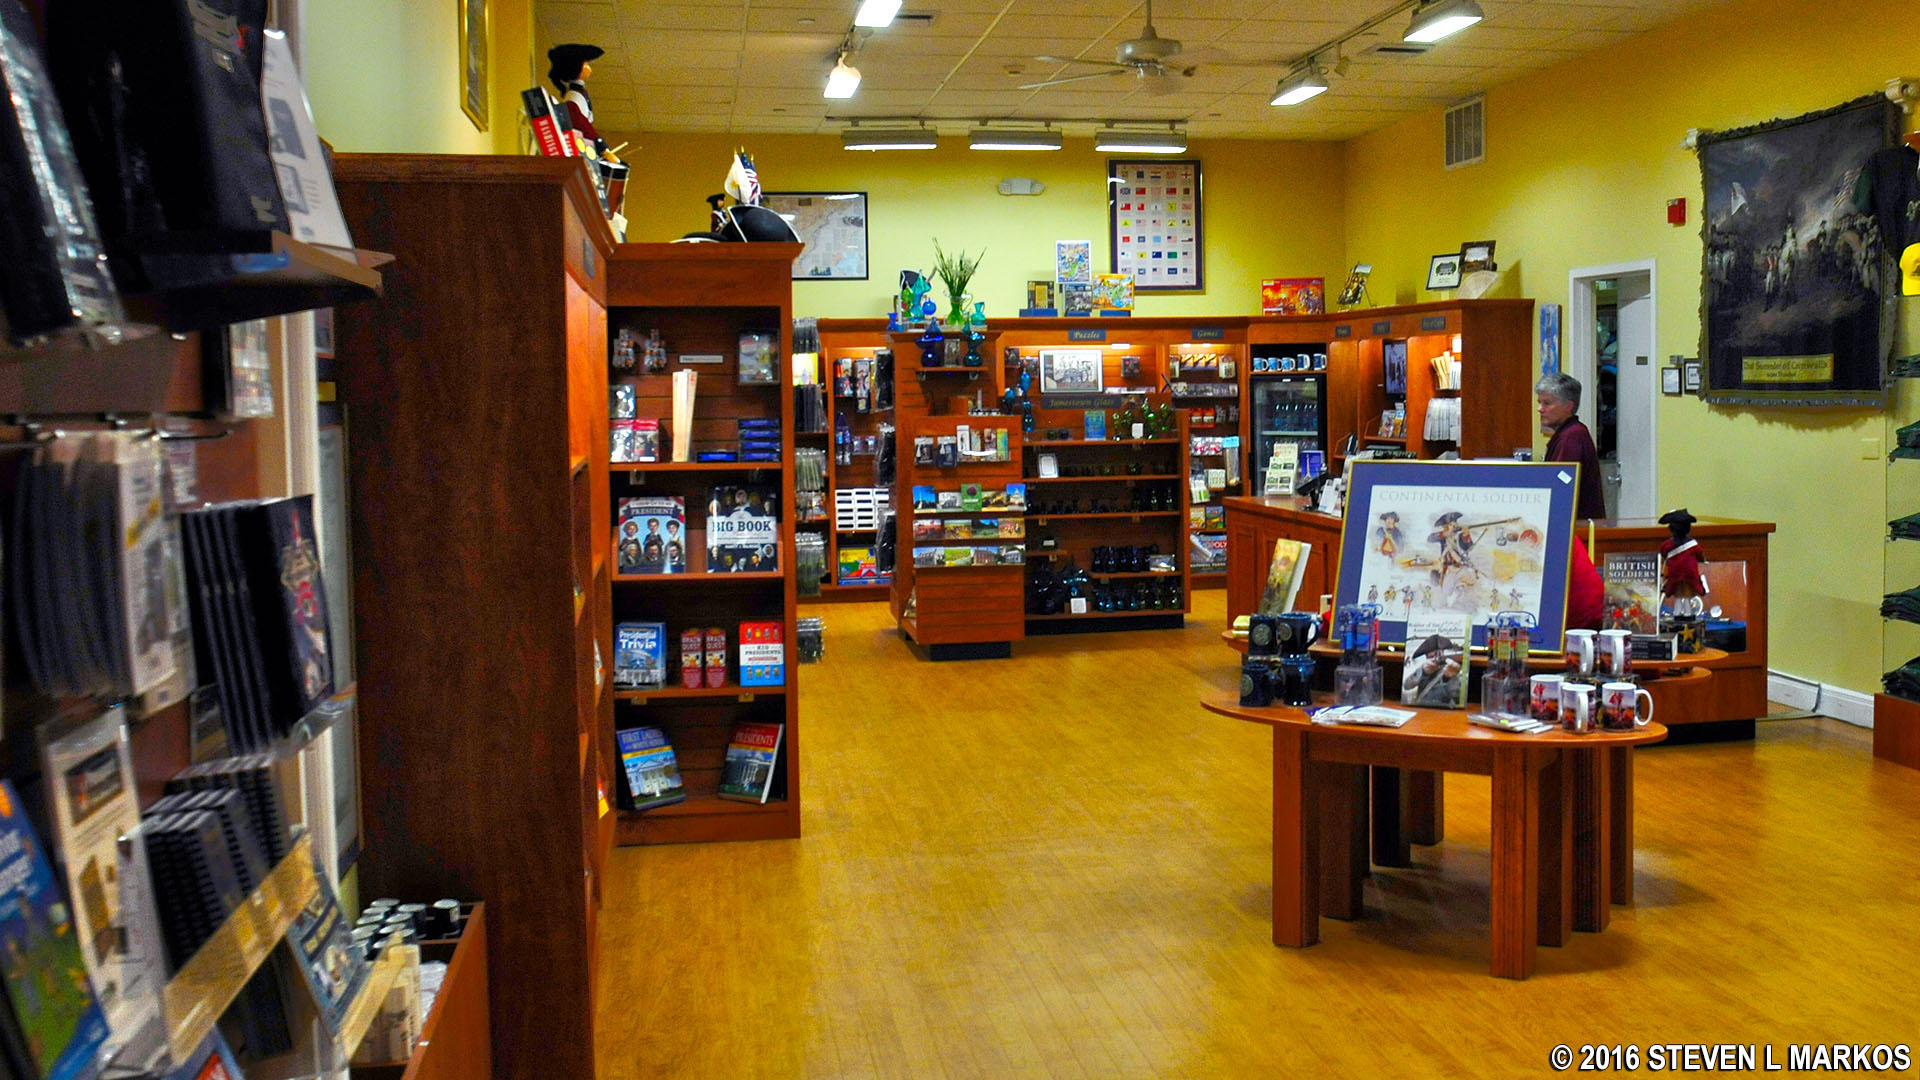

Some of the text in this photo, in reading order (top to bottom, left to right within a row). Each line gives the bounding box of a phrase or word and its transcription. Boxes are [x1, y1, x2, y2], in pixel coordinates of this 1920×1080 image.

[1073, 330, 1100, 339] Puzzles
[1197, 330, 1218, 338] Games
[1050, 398, 1092, 408] Jamestown
[1379, 490, 1543, 504] CONTINENTAL SOLDIER
[630, 508, 674, 516] PRESIDENT
[712, 520, 772, 532] BIG BOOK
[1608, 561, 1656, 570] BRITISH
[1608, 570, 1656, 578] SOLDIERS
[619, 630, 657, 640] Presidential
[619, 639, 657, 650] Trivia
